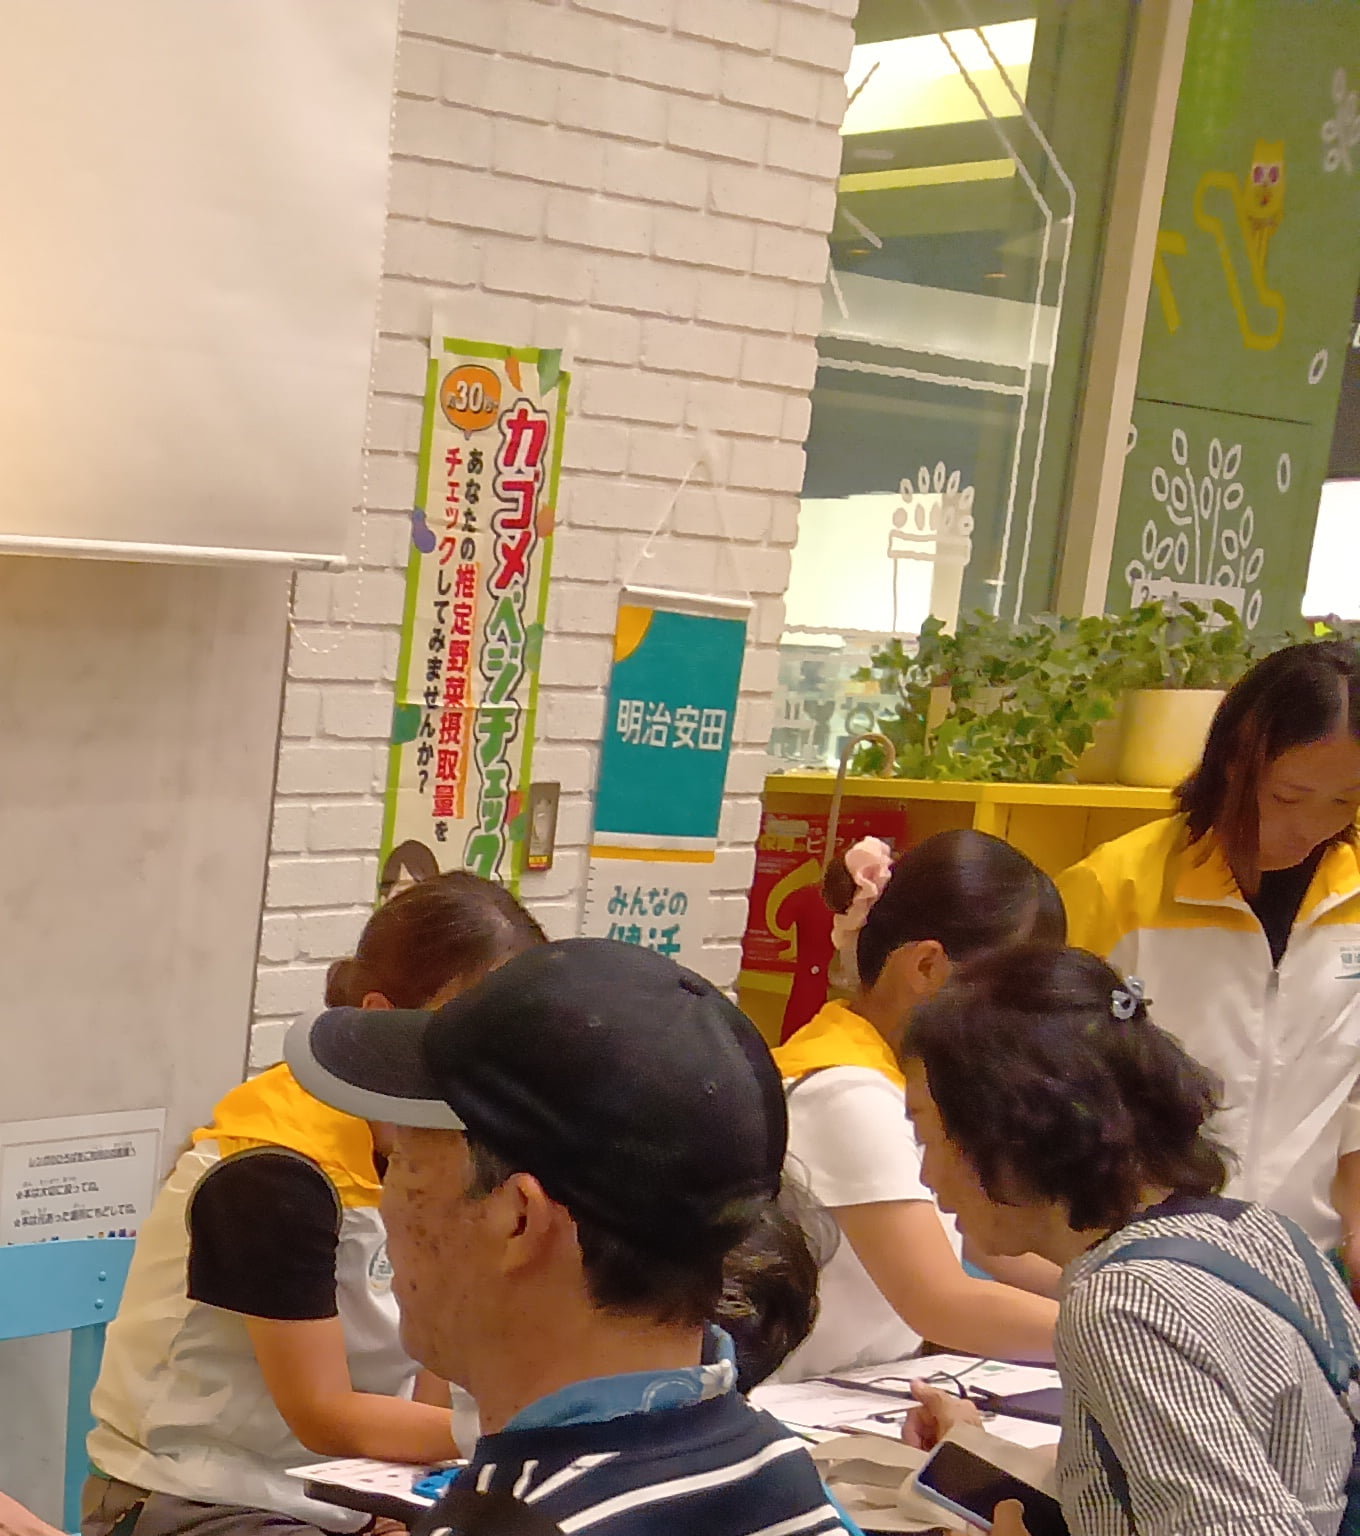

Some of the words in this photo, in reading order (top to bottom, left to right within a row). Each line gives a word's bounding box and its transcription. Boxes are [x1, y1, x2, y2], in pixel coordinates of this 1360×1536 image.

[616, 698, 727, 750] 明治安田
[607, 885, 689, 917] みんなの
